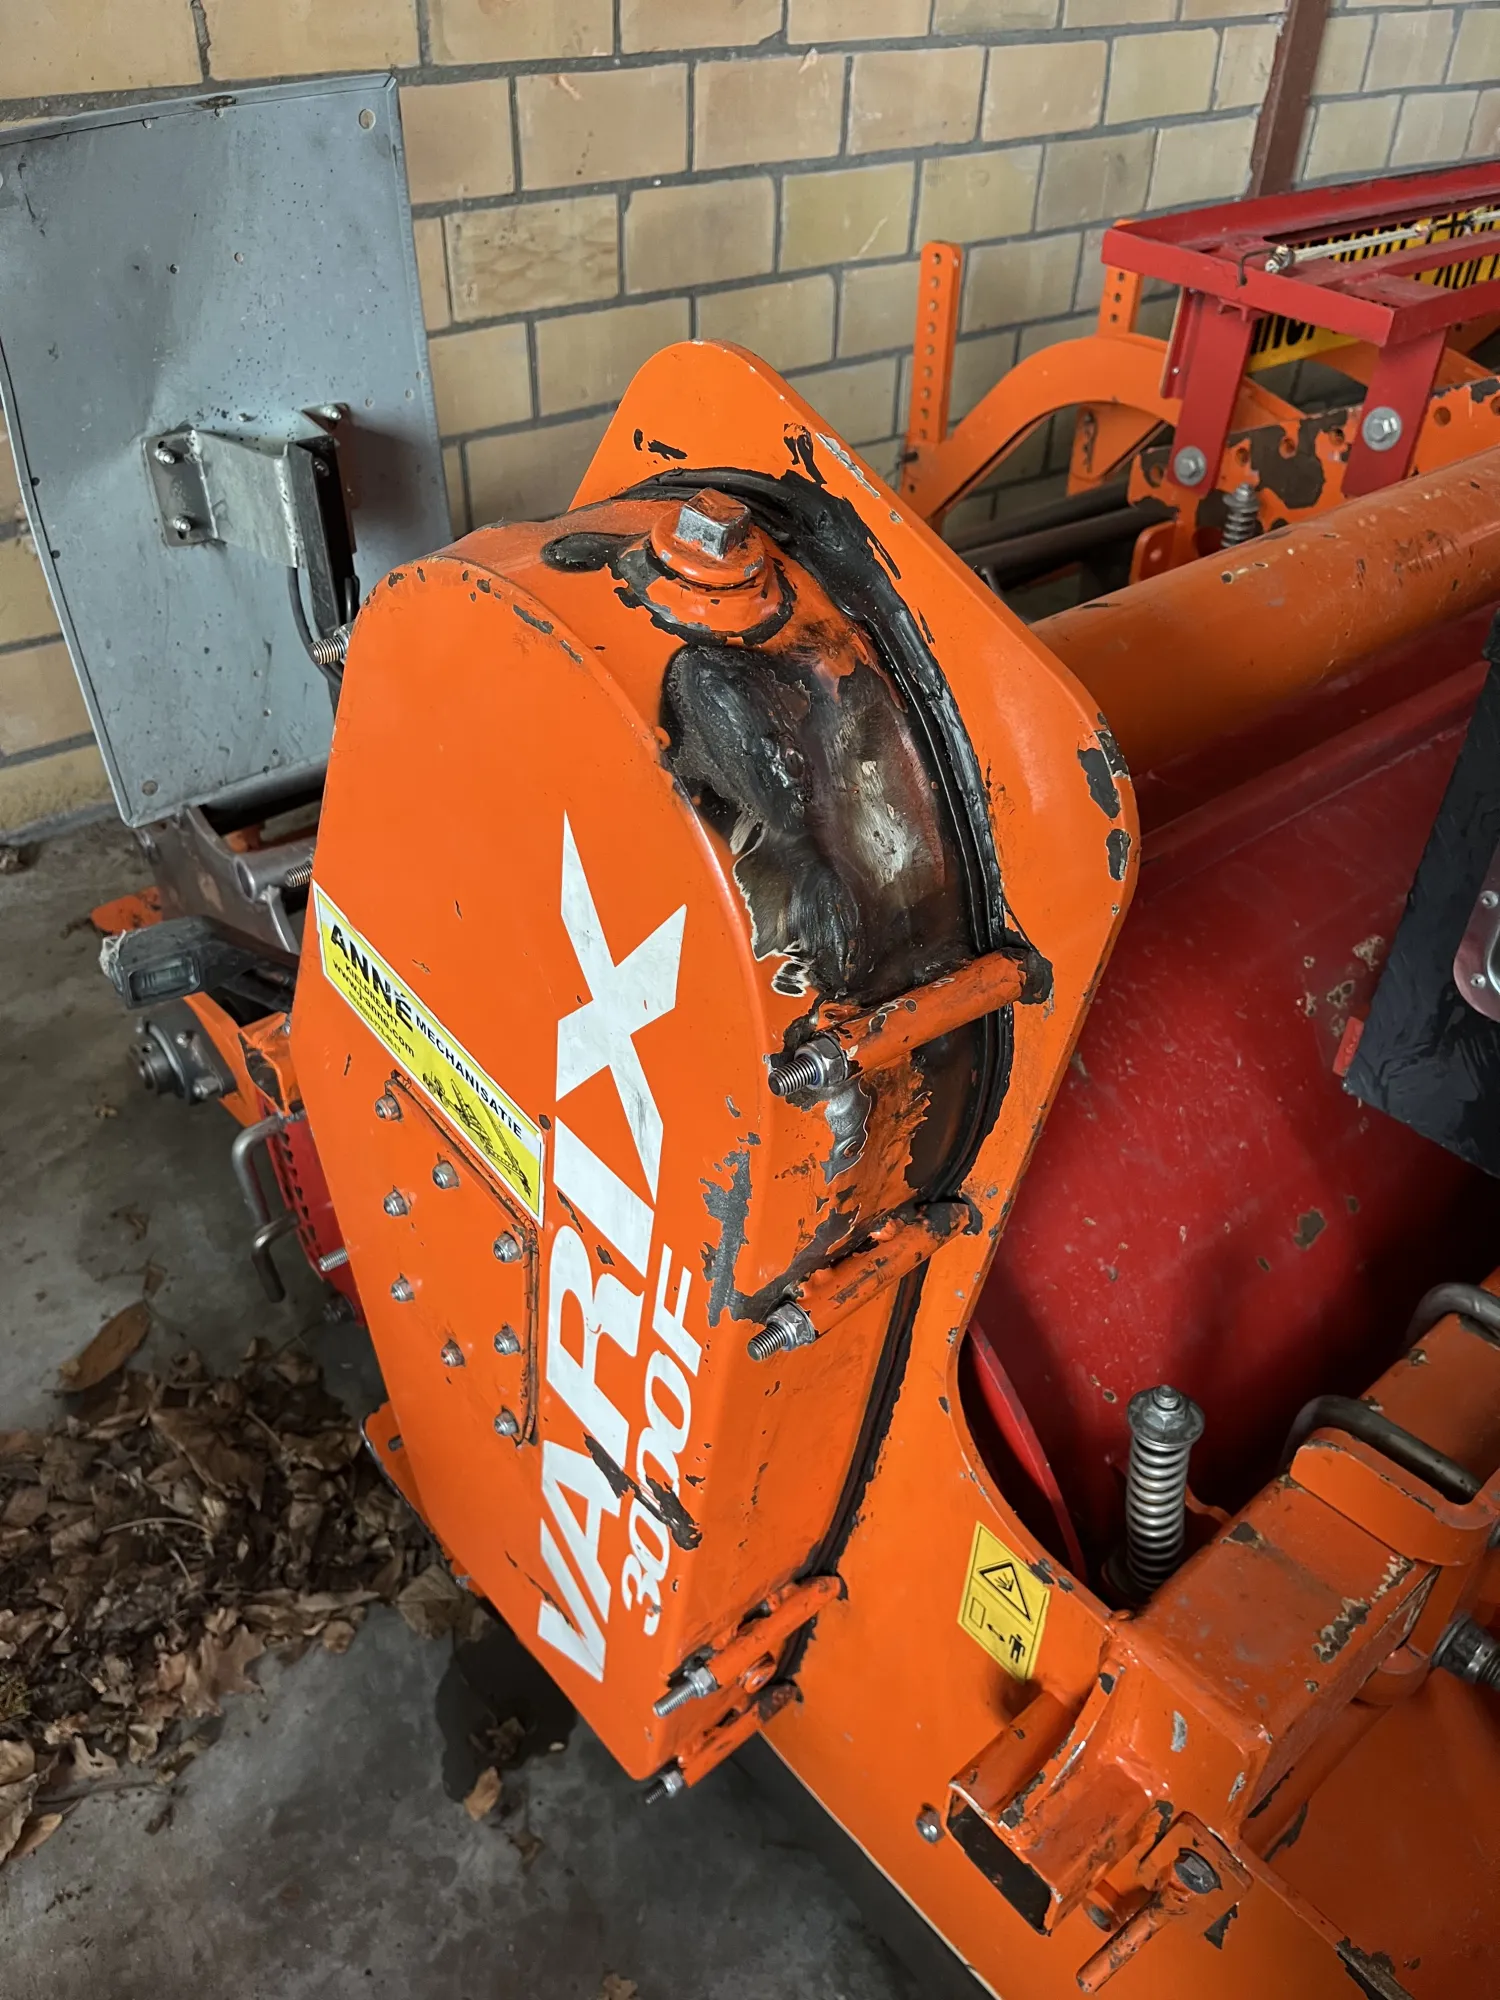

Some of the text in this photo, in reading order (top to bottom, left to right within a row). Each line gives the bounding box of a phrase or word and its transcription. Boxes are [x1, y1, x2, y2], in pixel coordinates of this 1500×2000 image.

[345, 962, 399, 1027] KIELDRECHT
[416, 1014, 523, 1140] MECHANISATIE
[535, 809, 688, 1683] VARIX
[621, 1242, 702, 1637] 3000F
